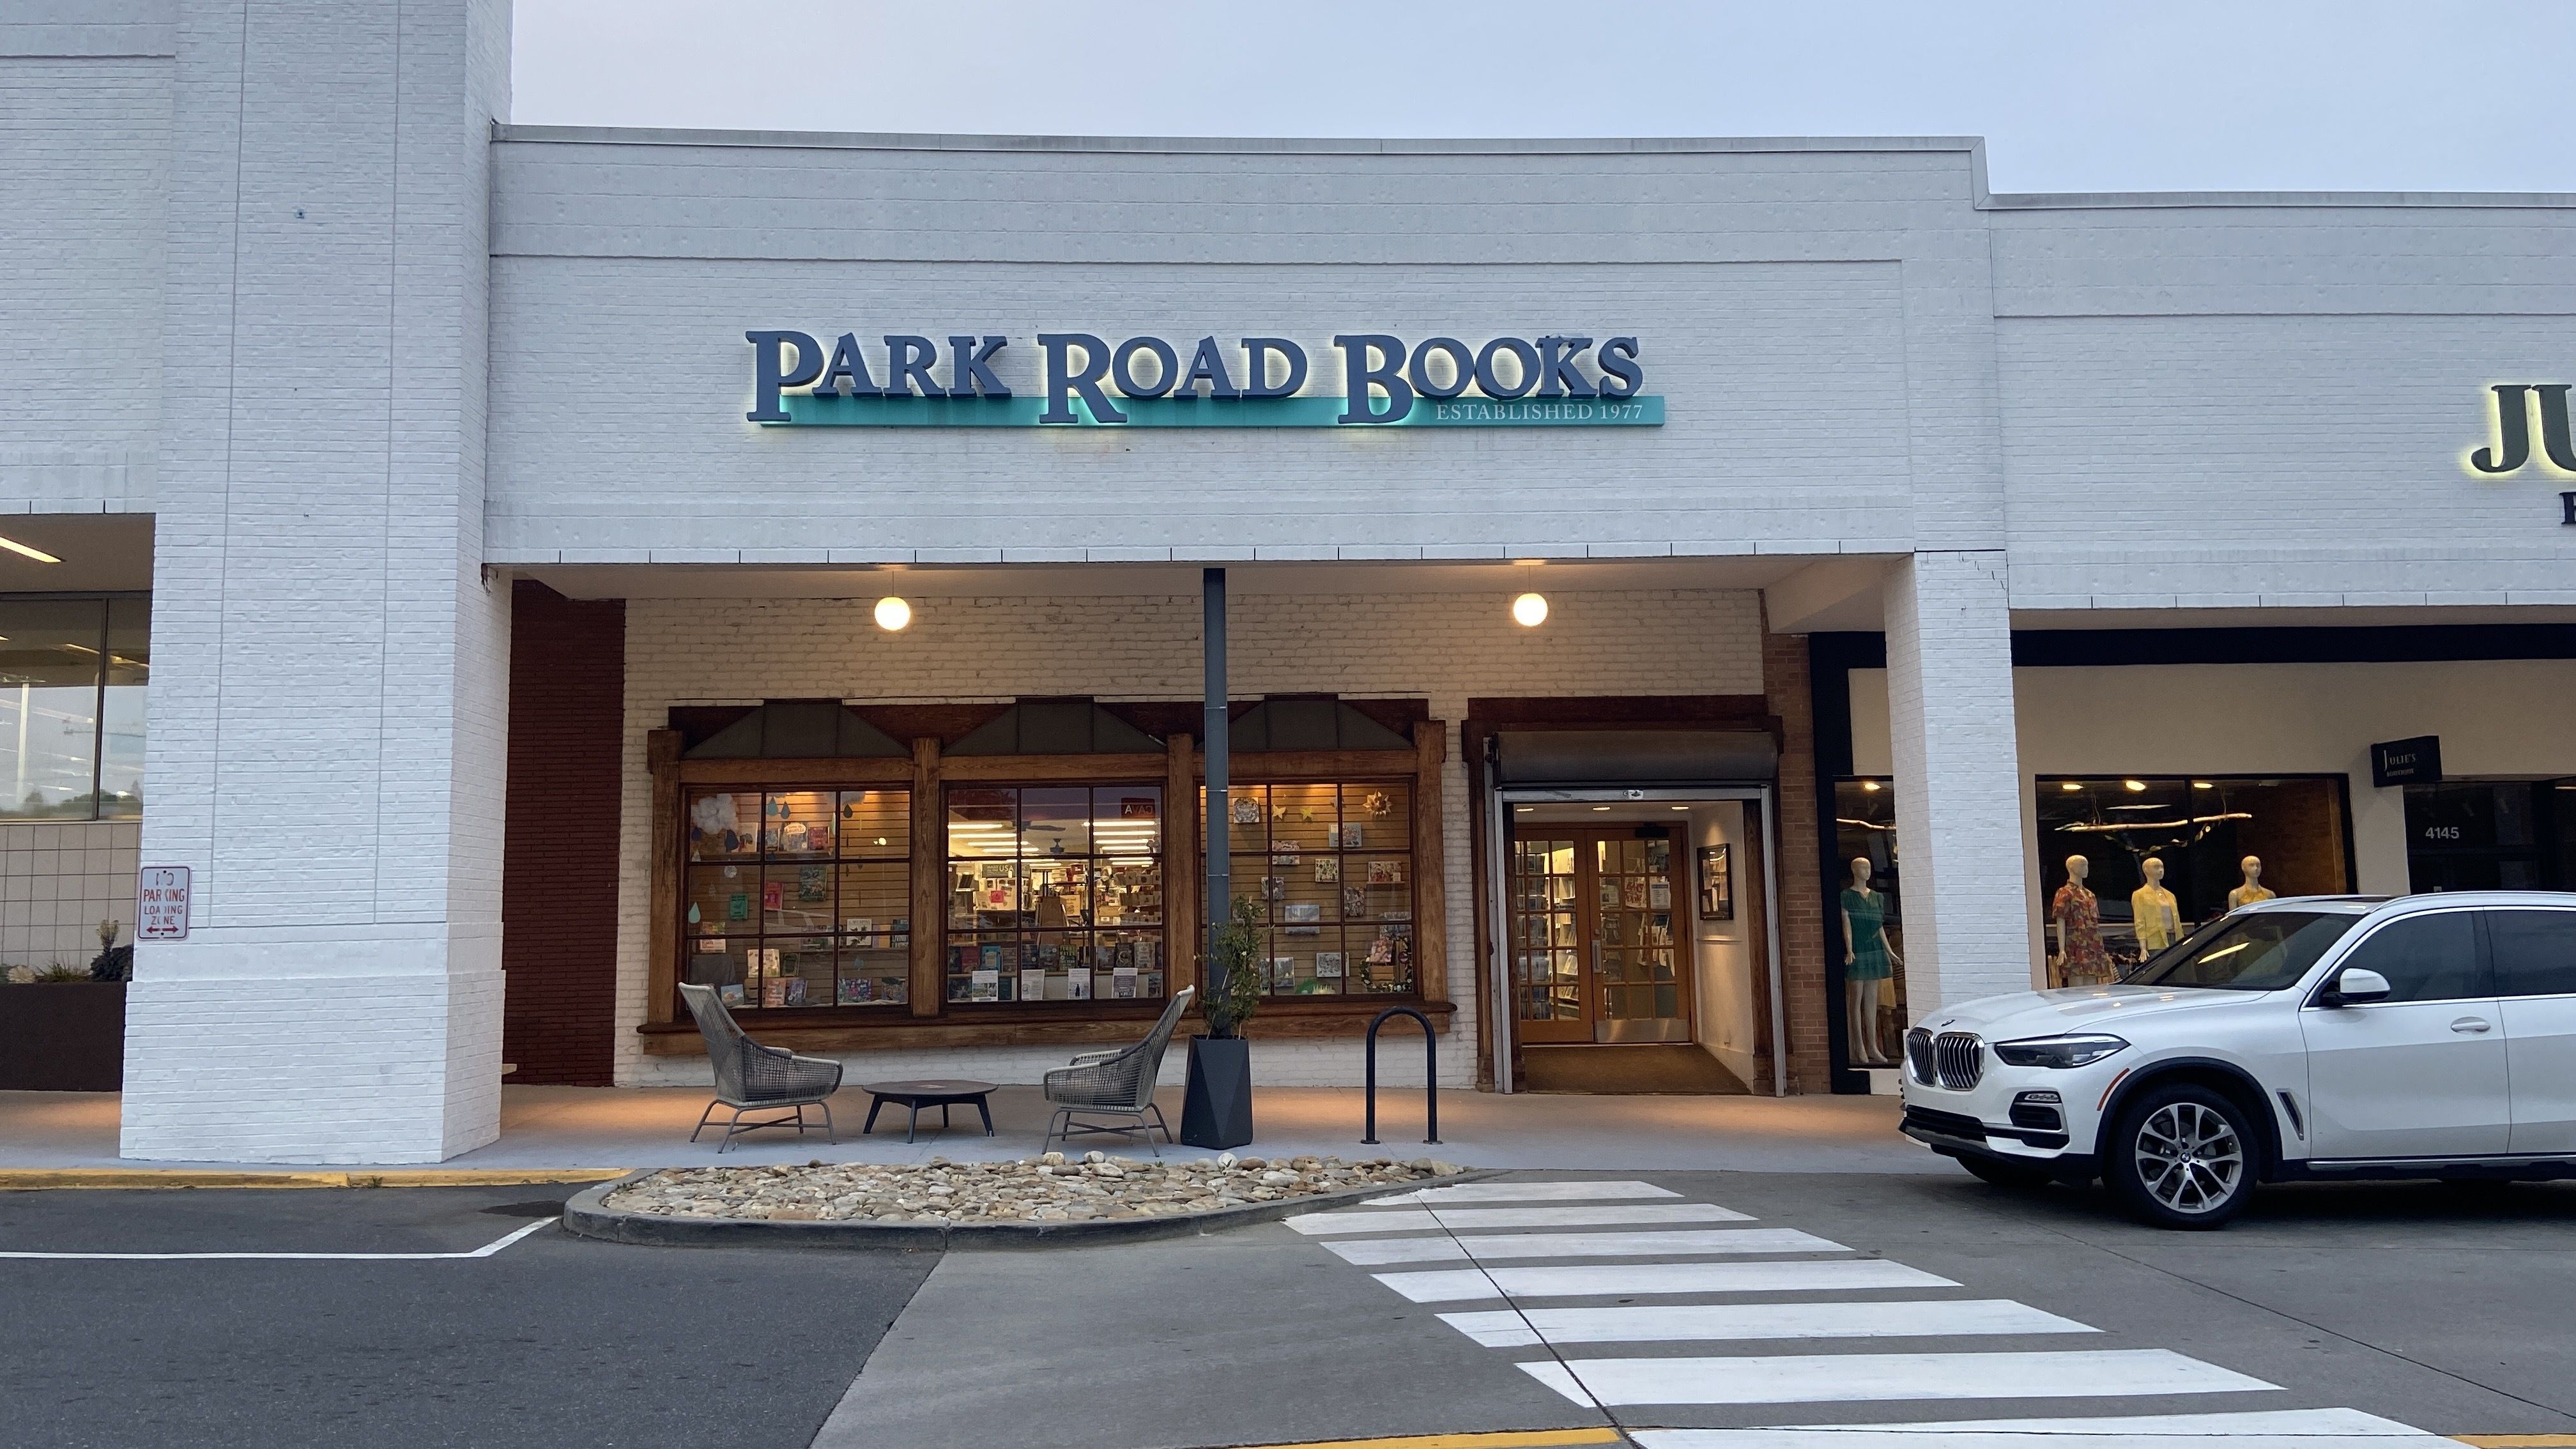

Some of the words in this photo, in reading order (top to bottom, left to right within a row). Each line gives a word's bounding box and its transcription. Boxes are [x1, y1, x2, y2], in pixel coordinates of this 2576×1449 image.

[746, 330, 1012, 422] PARK
[1037, 333, 1308, 424] ROAD
[1334, 334, 1643, 424] BOOKS
[1436, 404, 1593, 420] ESTABLISHED
[1599, 404, 1644, 420] 1977
[2425, 827, 2460, 839] 4145
